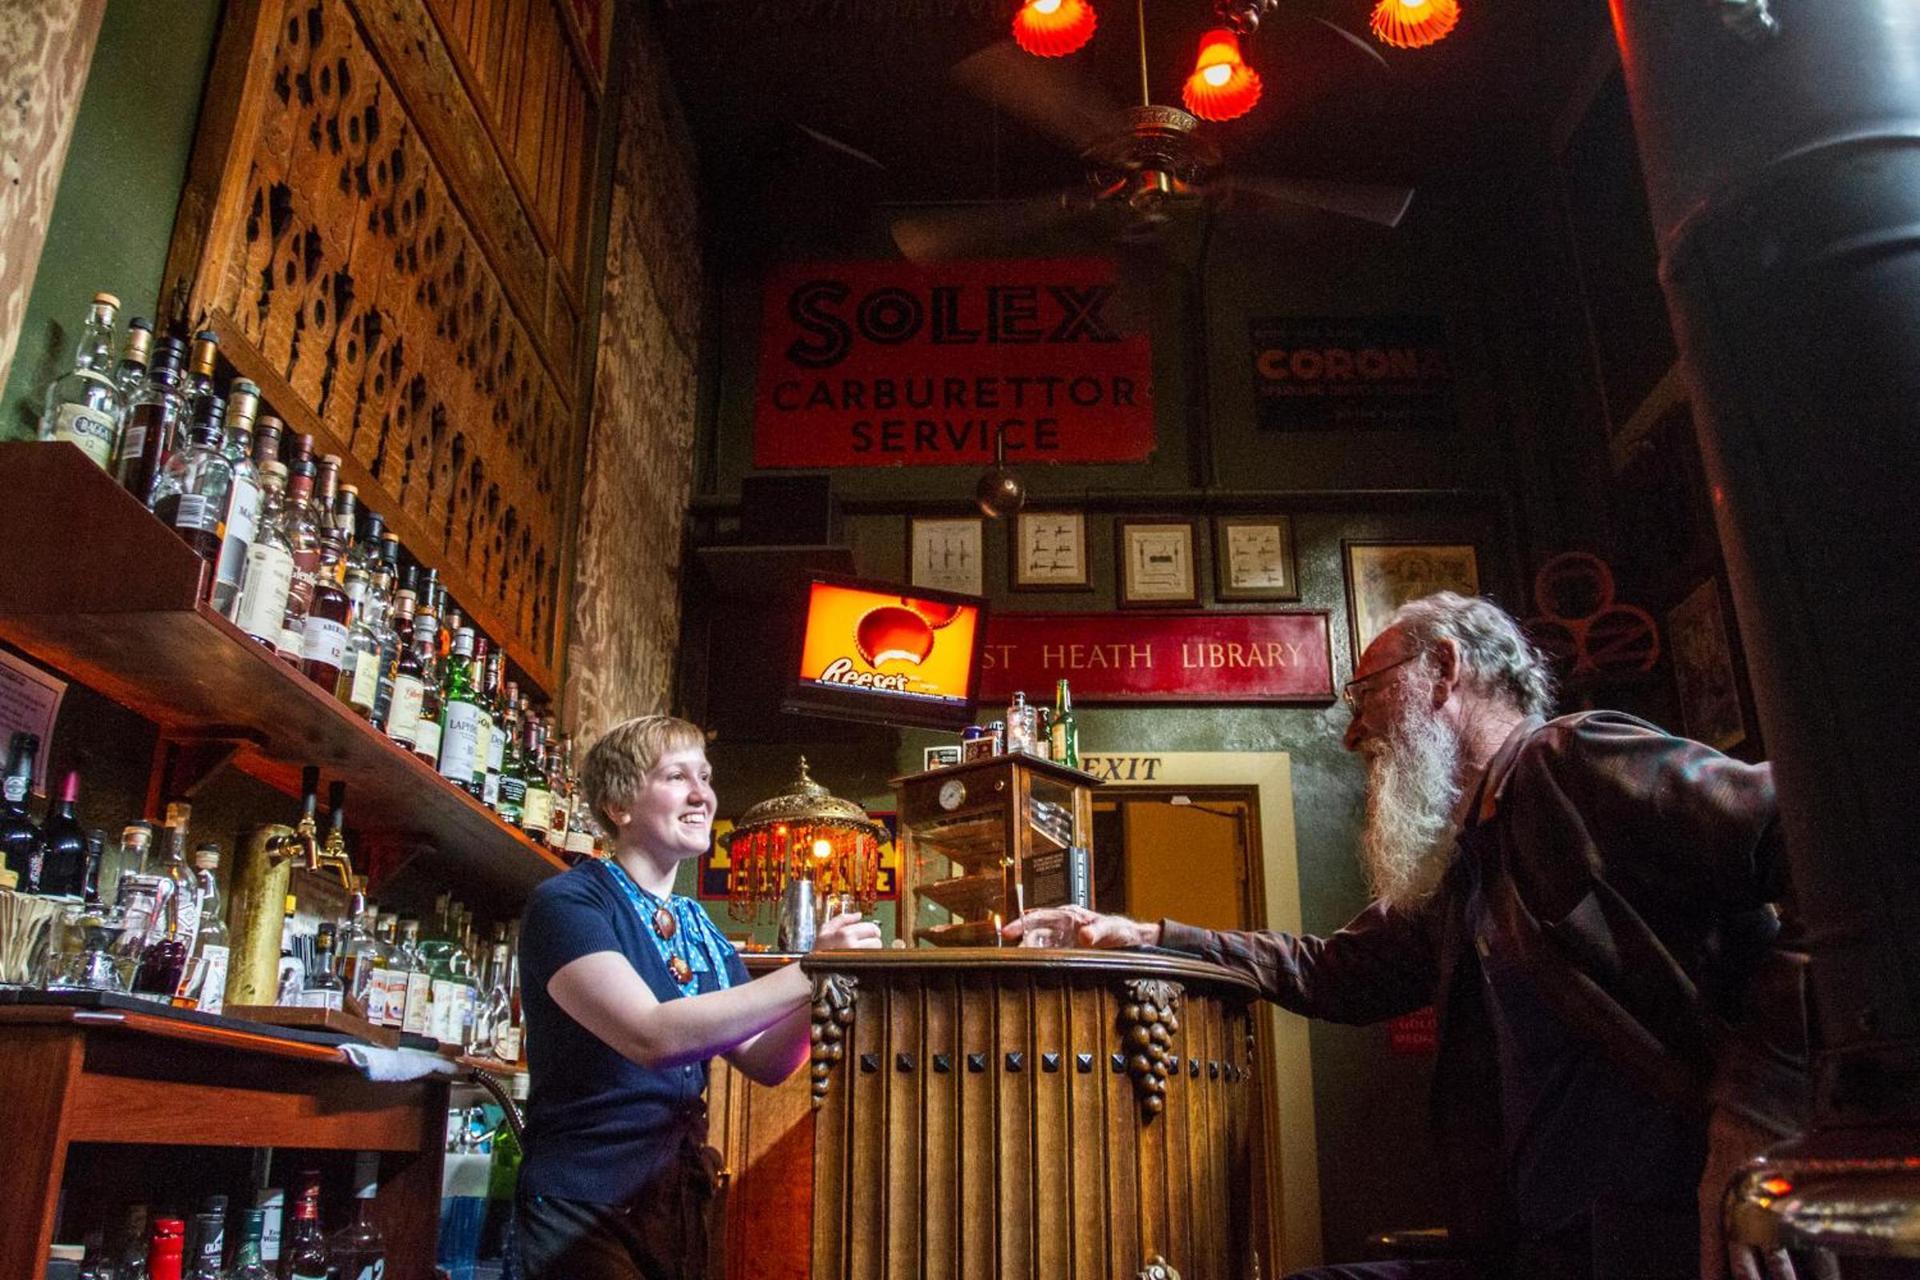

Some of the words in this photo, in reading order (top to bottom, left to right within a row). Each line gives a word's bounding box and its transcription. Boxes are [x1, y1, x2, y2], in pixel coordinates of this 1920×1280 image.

[786, 279, 1122, 369] SOLEX
[772, 376, 1137, 412] CARBURETTOR
[852, 418, 1061, 452] SERVICE
[1043, 644, 1153, 669] HEATH
[1182, 642, 1303, 668] LIBRARY
[1082, 757, 1162, 780] EXIT
